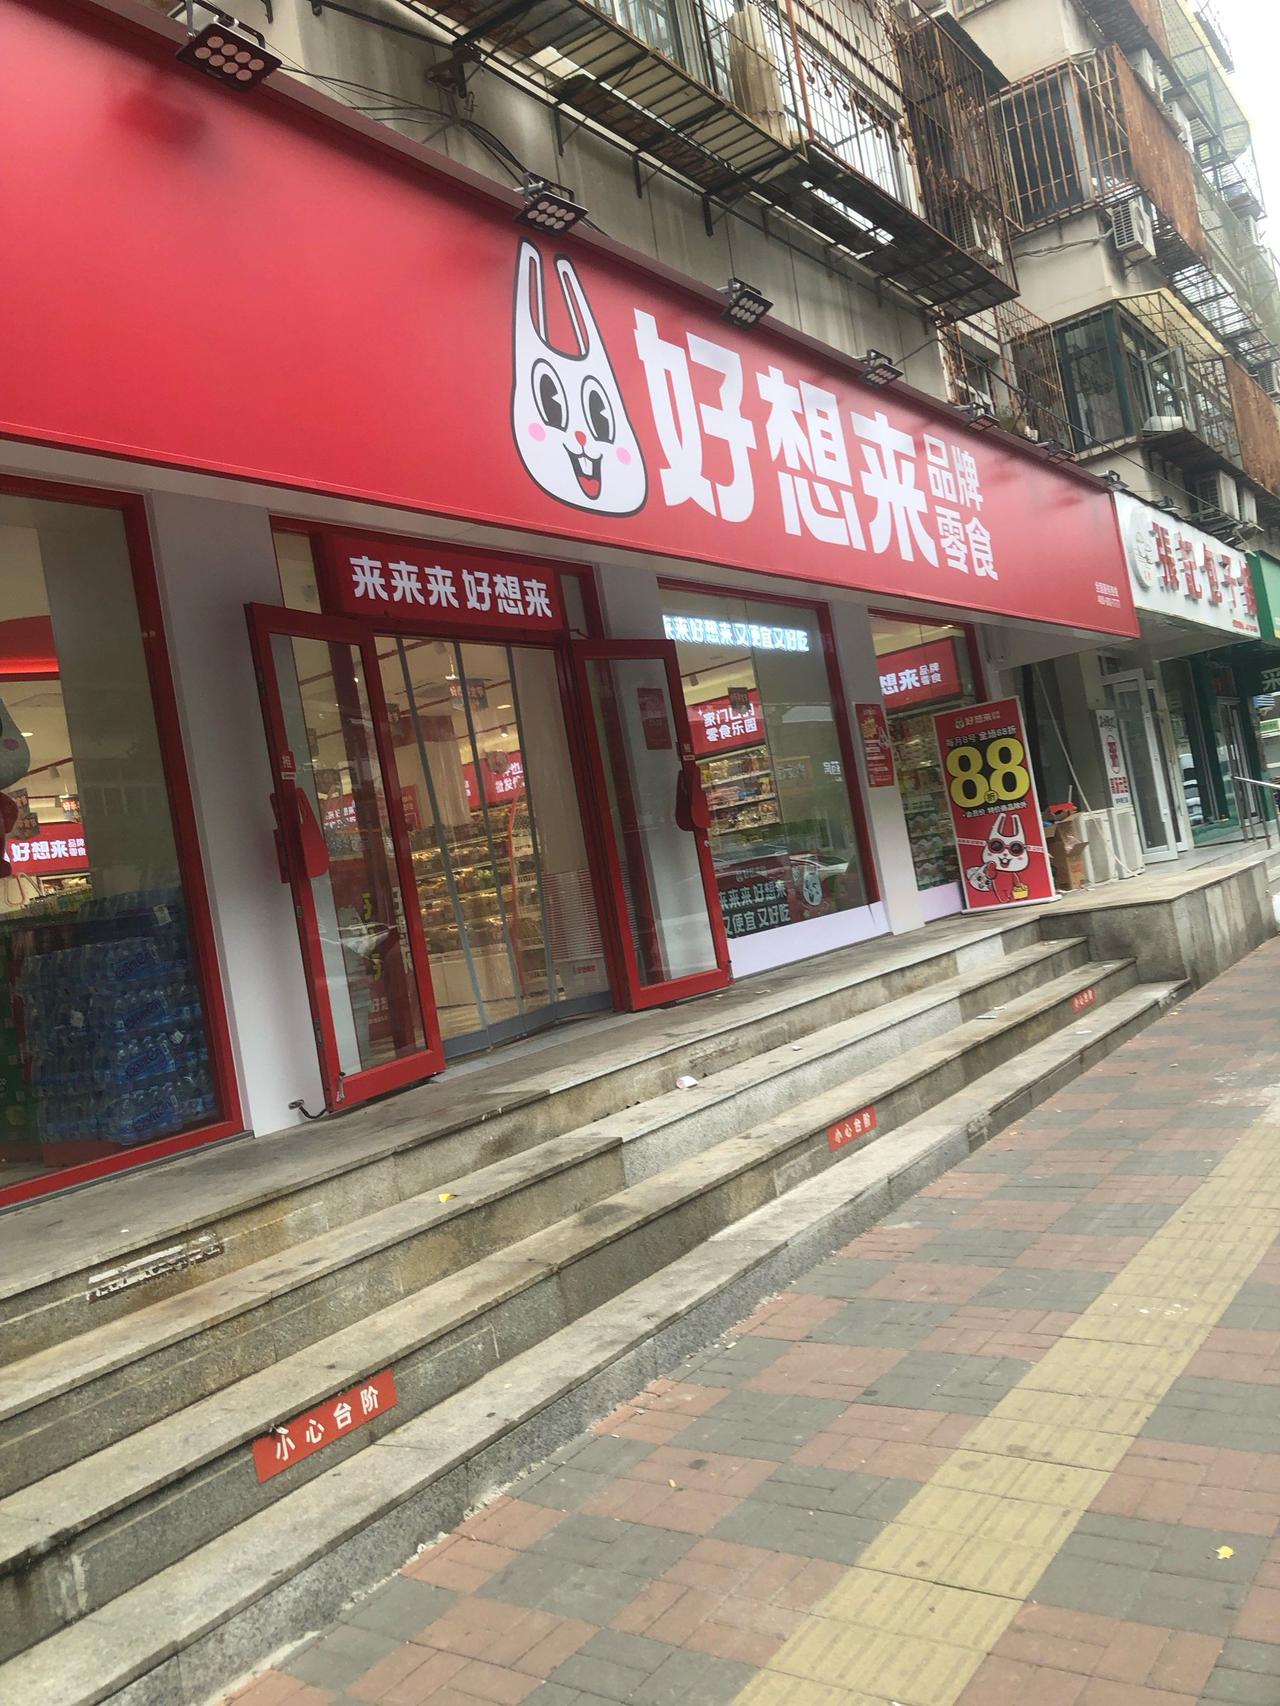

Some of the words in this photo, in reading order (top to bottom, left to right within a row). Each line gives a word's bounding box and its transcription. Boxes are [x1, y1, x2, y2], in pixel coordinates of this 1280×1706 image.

[633, 308, 939, 568] 好想来
[923, 432, 984, 512] 品牌
[933, 505, 999, 581] 零食
[349, 555, 460, 609] 来来来
[462, 568, 553, 618] 好想来
[706, 717, 758, 742] 零食乐园
[946, 738, 1030, 808] 88
[10, 839, 69, 863] 好想来
[753, 879, 788, 903] 好想来
[757, 903, 791, 928] 又好吃
[834, 1111, 871, 1144] 小心台阶
[276, 1385, 379, 1461] 小心台阶
